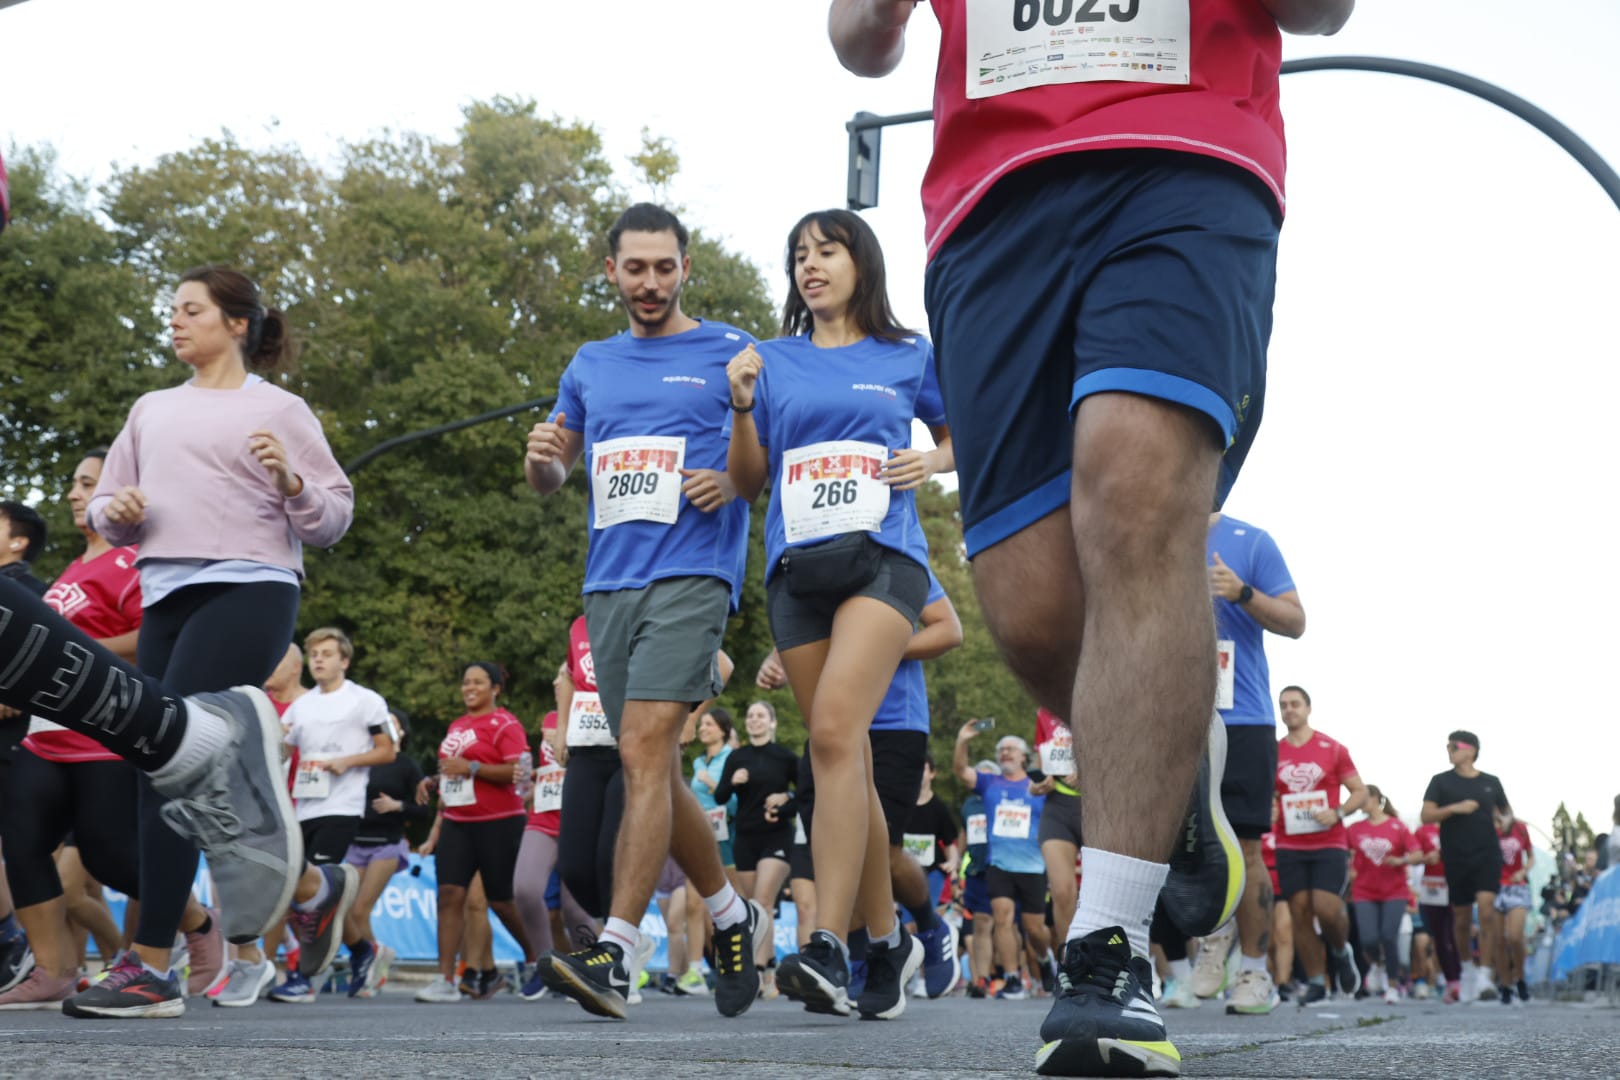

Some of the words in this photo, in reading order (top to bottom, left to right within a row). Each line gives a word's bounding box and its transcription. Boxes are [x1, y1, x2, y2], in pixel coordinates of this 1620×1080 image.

[608, 472, 659, 499] 2809
[812, 479, 858, 509] 266
[579, 714, 608, 729] 5952
